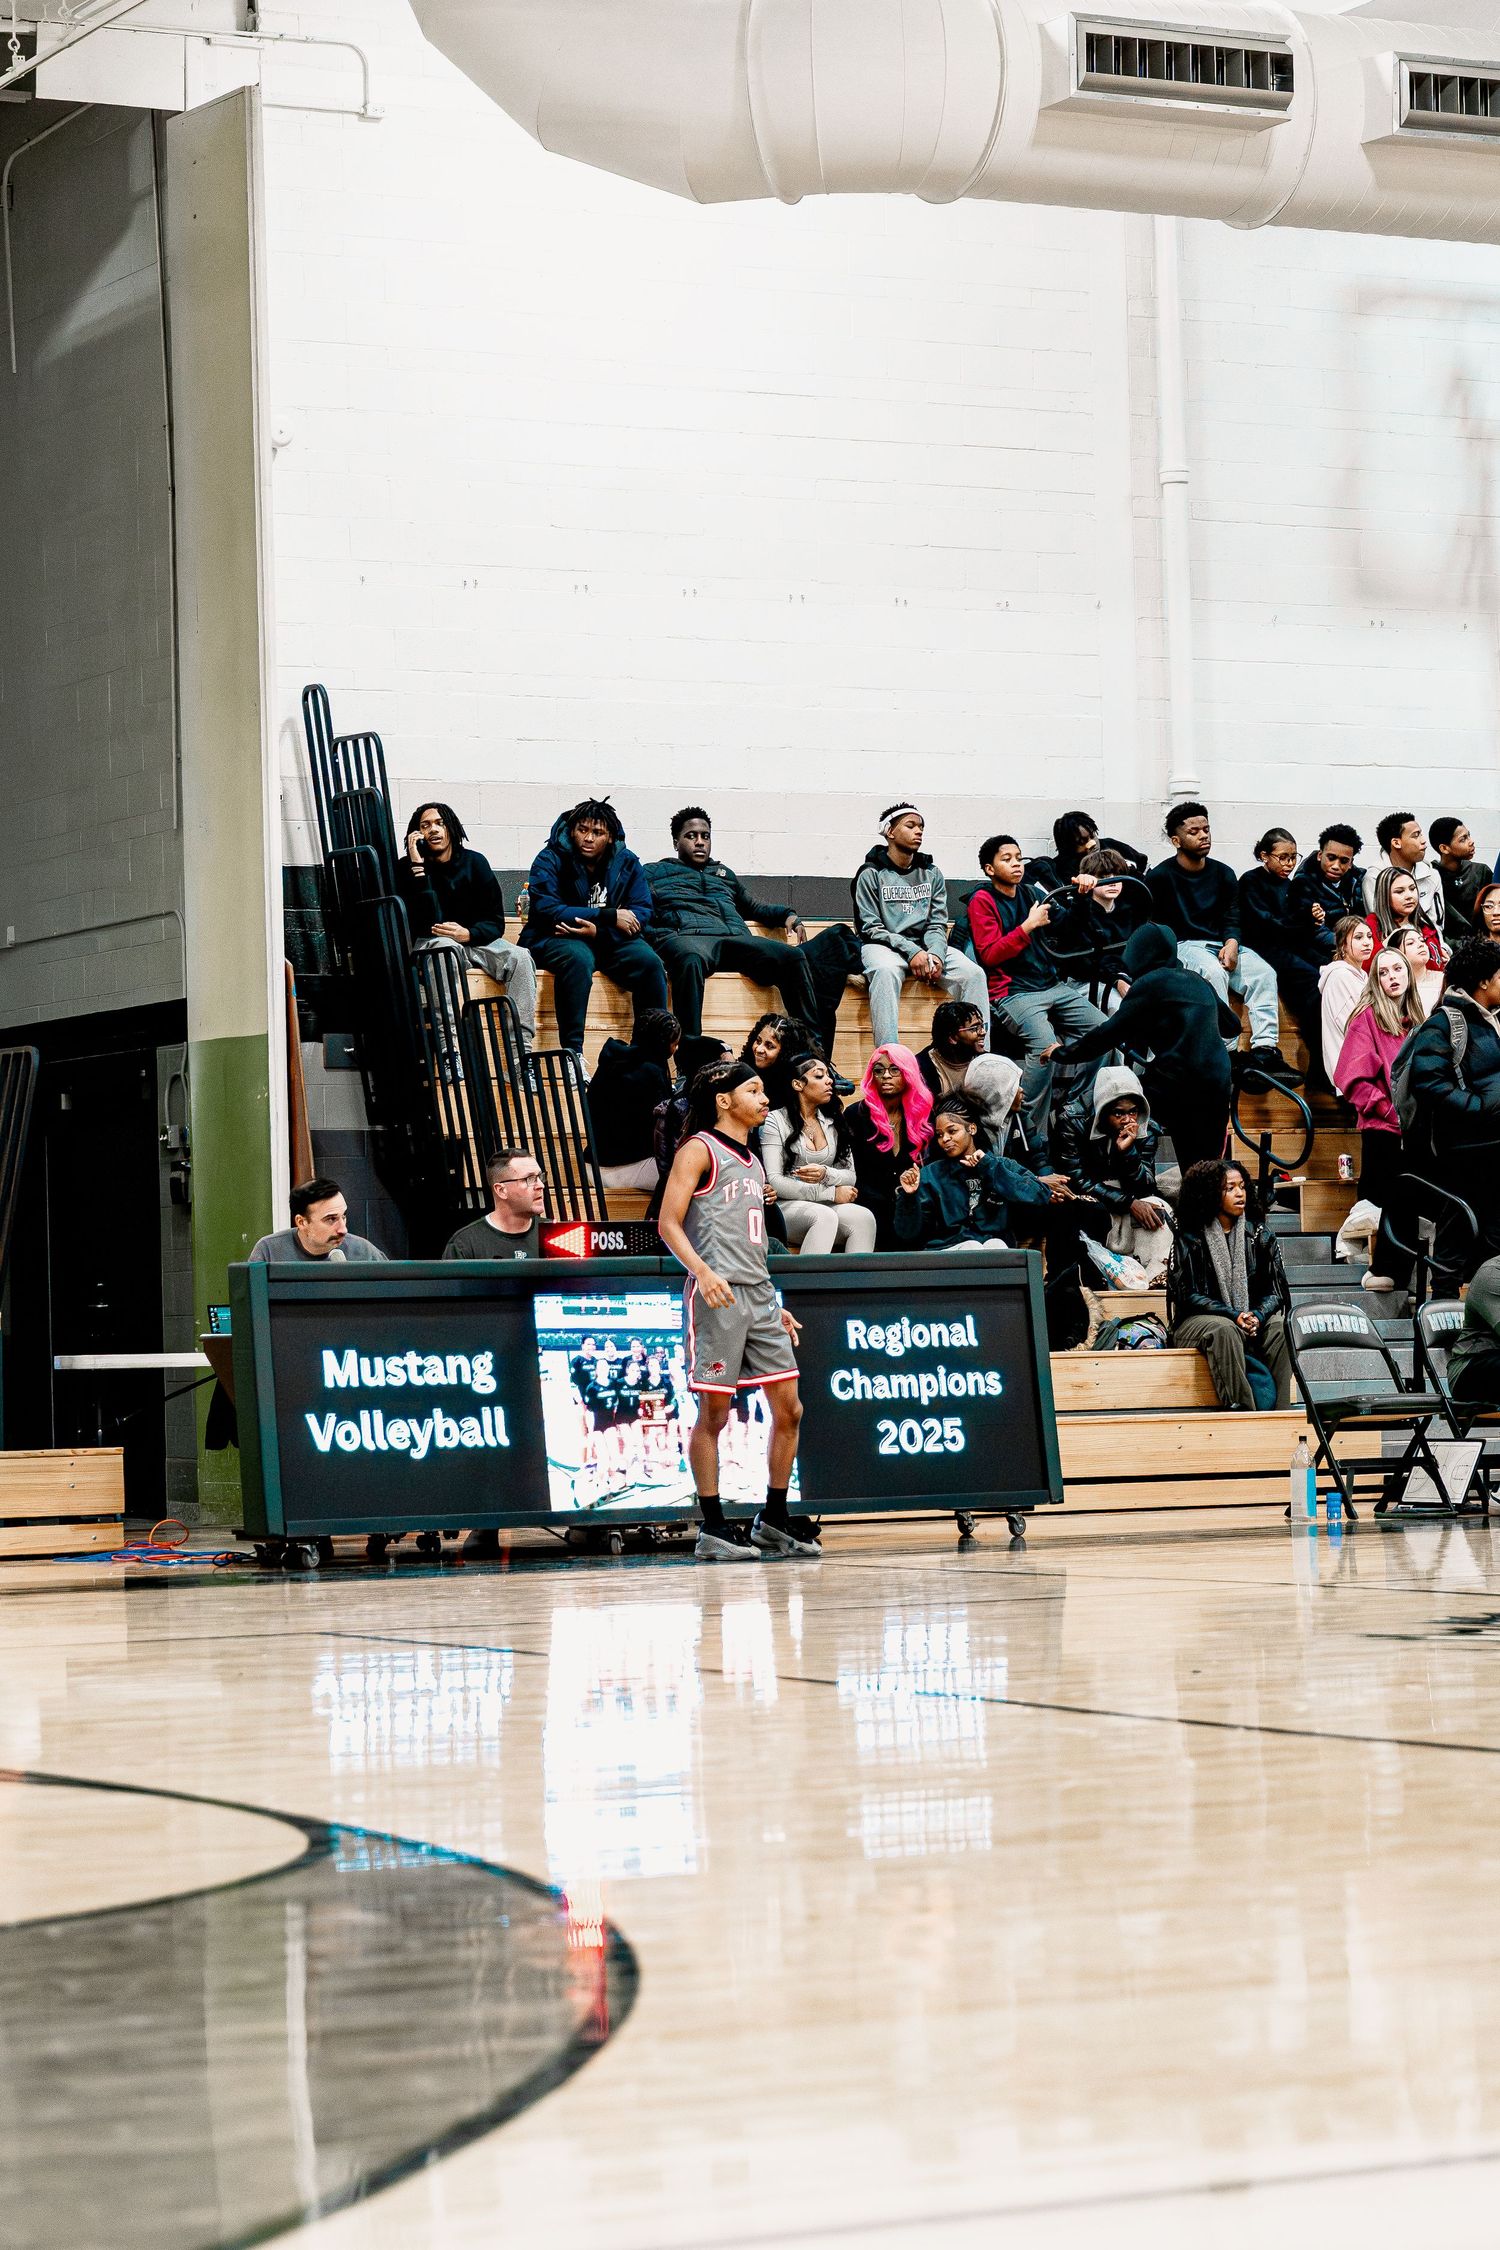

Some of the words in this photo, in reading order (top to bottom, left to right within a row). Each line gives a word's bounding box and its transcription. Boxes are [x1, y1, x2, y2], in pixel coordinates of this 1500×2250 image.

[1340, 1158, 1352, 1167] ke
[723, 1180, 739, 1203] TF
[743, 1178, 764, 1204] SOU
[590, 1231, 628, 1250] POSS.
[748, 1208, 763, 1245] 0
[846, 1314, 979, 1356] Regional
[1296, 1313, 1369, 1335] MUSTANGS
[1426, 1311, 1465, 1332] MUST
[322, 1349, 497, 1394] Mustang
[830, 1366, 1003, 1405] Champions
[305, 1406, 510, 1460] Volleyball
[876, 1417, 965, 1454] 2025
